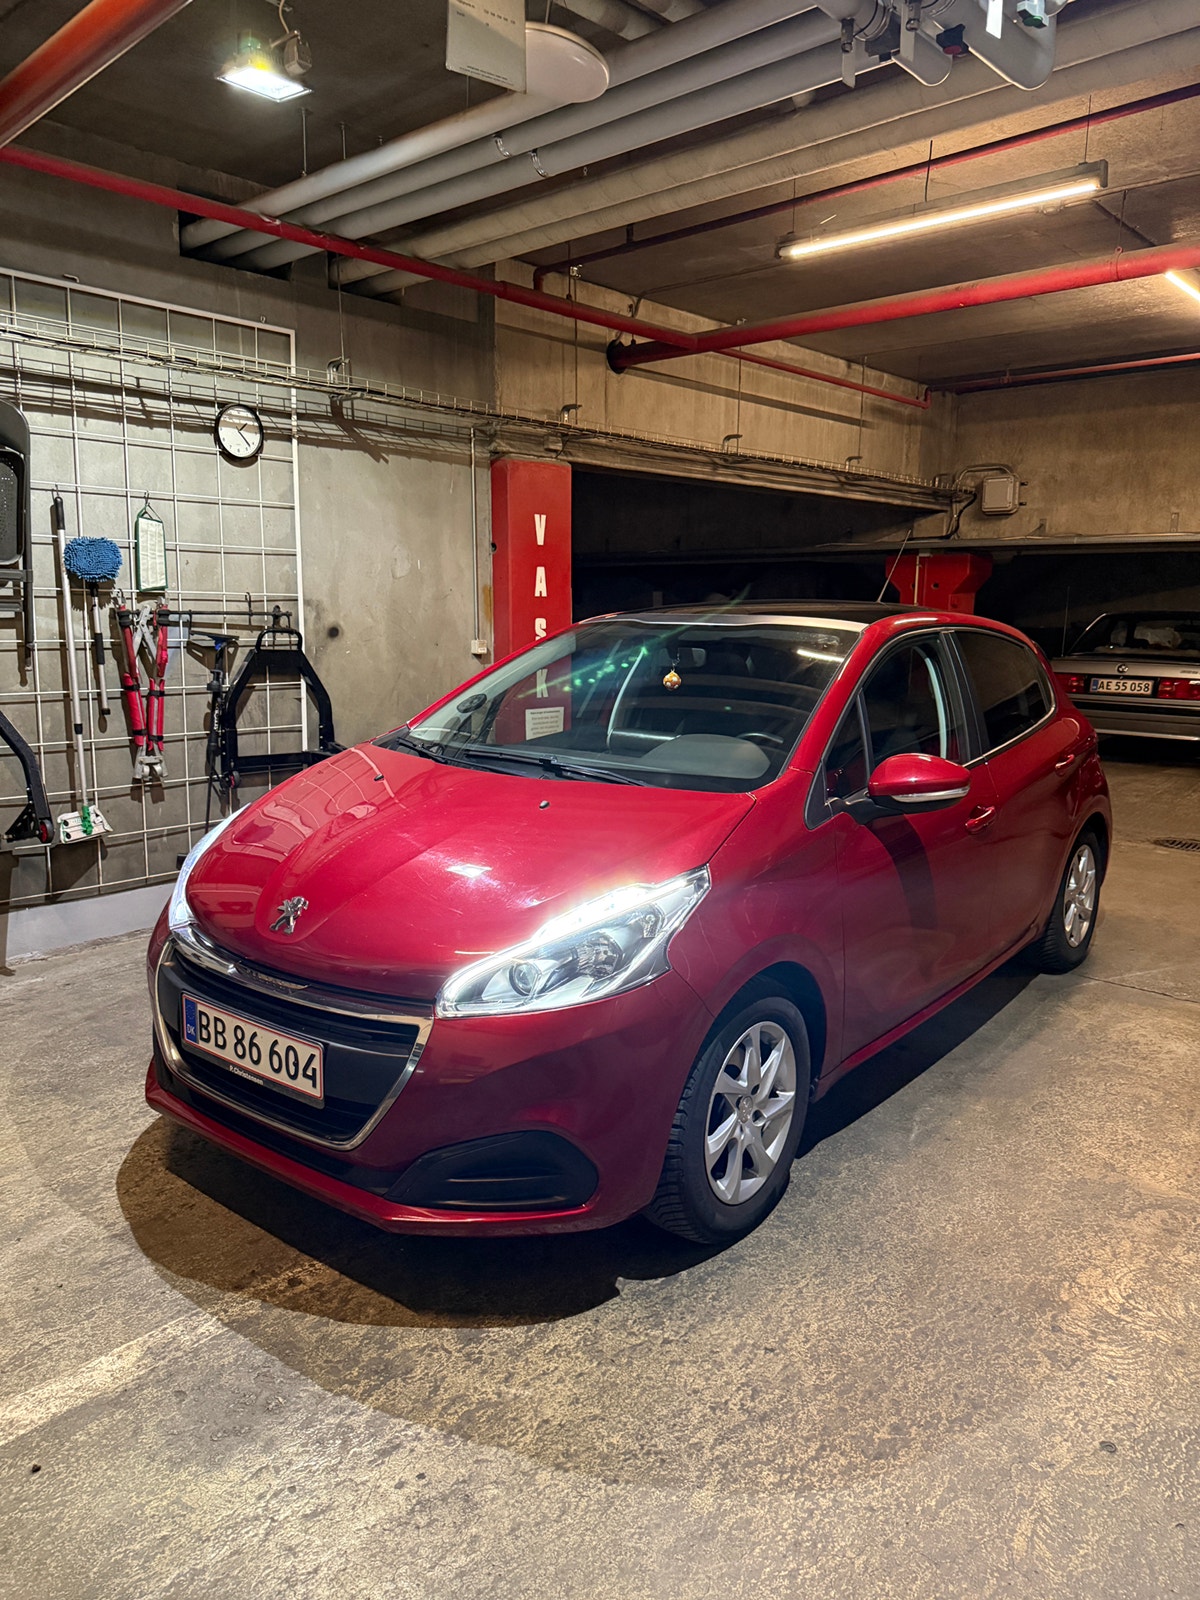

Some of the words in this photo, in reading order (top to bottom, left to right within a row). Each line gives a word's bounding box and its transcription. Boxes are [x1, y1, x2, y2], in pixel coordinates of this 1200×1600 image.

[534, 513, 548, 698] VASK
[1098, 681, 1112, 691] AE
[1114, 681, 1128, 691] 55
[1130, 682, 1150, 693] 058
[187, 1023, 196, 1037] DK
[199, 1009, 227, 1050] BB
[233, 1024, 262, 1065] 86
[269, 1039, 317, 1089] 604
